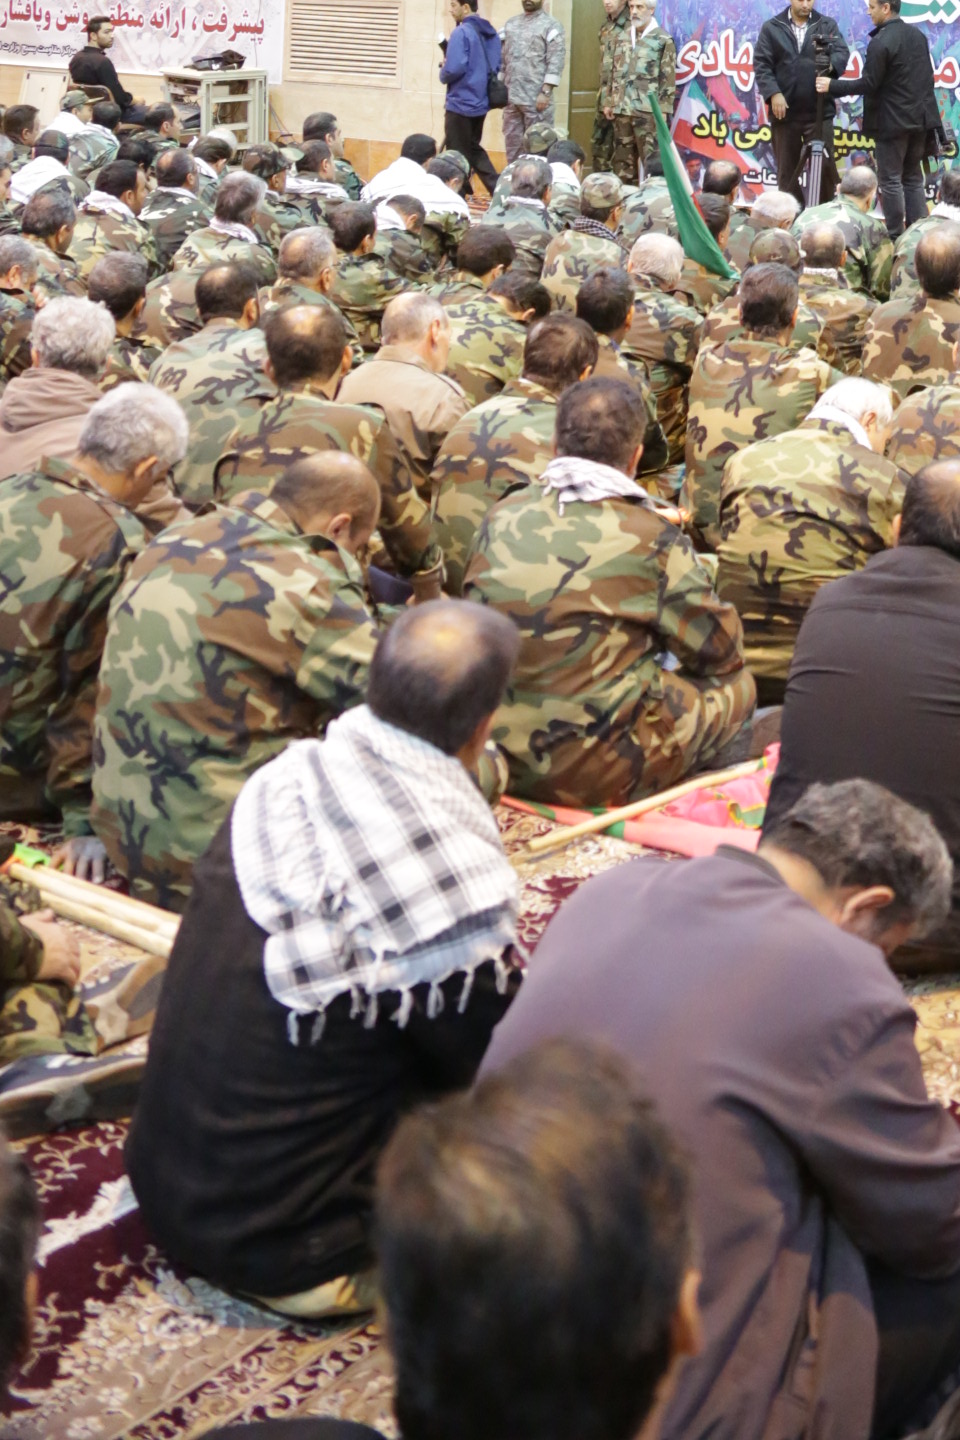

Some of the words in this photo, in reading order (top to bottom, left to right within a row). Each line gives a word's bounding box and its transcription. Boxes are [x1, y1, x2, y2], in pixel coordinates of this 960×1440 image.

[56, 2, 88, 31] وشن
[150, 2, 186, 38] ارائه
[202, 6, 265, 44] پیشرفت
[676, 29, 754, 91] هادی
[694, 113, 728, 145] باد
